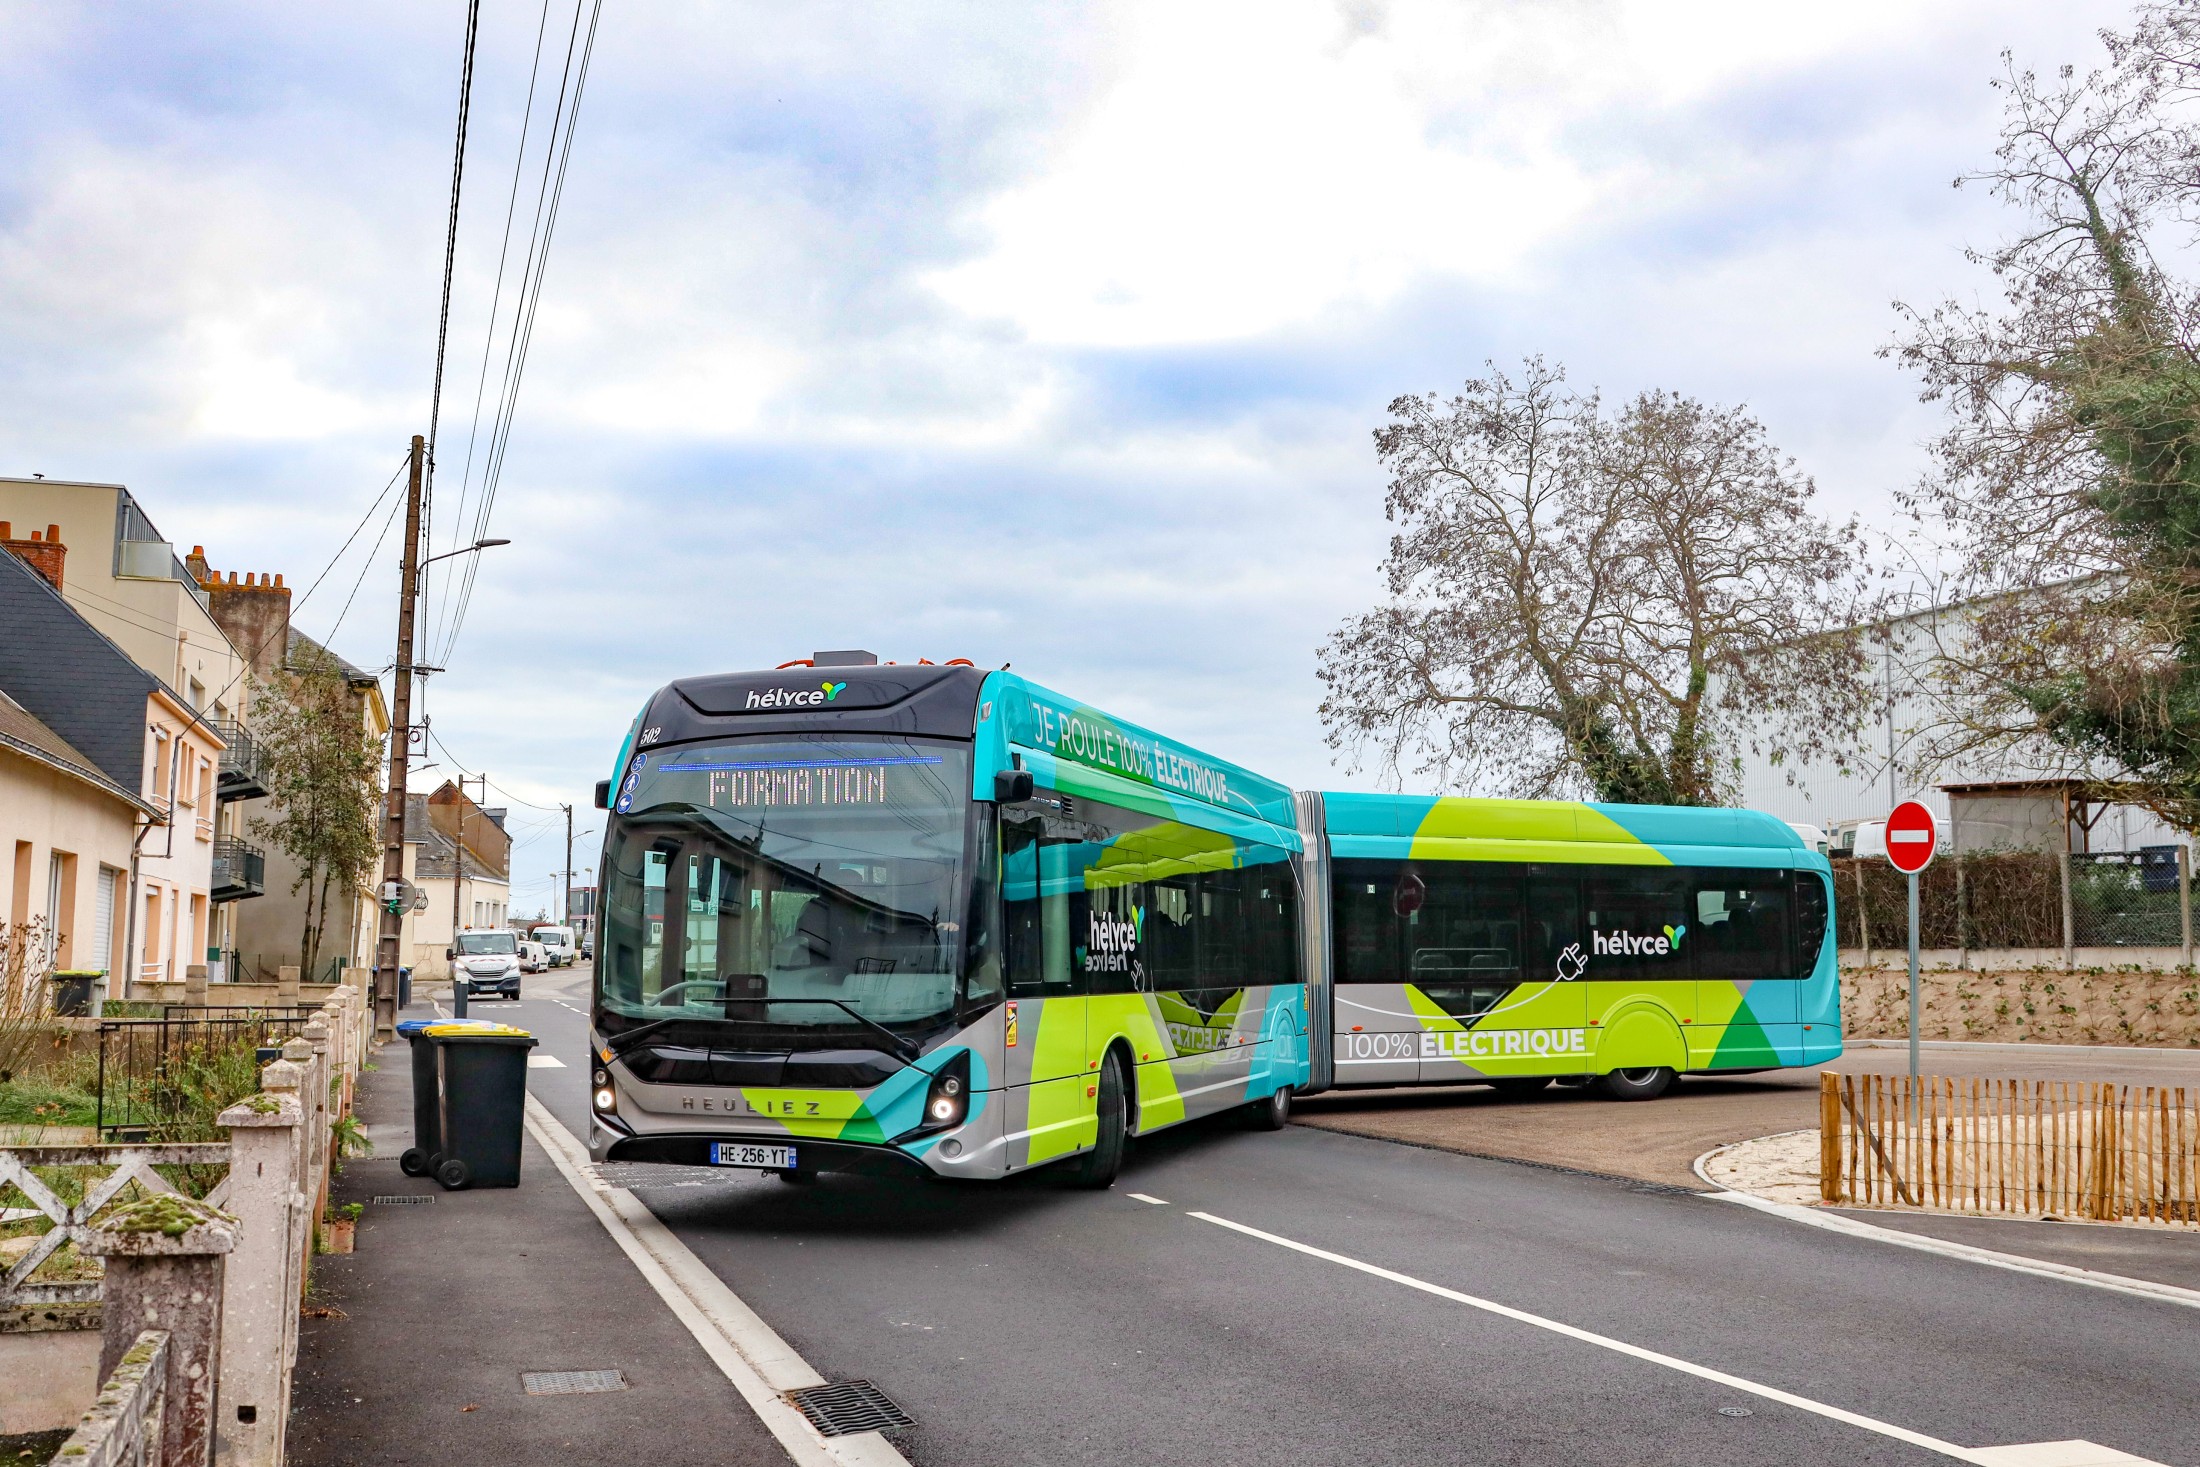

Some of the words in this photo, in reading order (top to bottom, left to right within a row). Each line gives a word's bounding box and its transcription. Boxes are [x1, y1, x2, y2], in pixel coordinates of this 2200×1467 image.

[745, 689, 824, 709] hélyce
[640, 726, 661, 745] 502
[1032, 702, 1056, 748] JE
[1058, 712, 1116, 767] ROULE
[1117, 735, 1153, 779] 100%
[1155, 741, 1229, 804] ÉLECTRIQUE
[708, 766, 885, 806] FORMATION
[1090, 910, 1136, 952] hélyce
[1593, 930, 1669, 956] hélyce
[1344, 1033, 1412, 1058] 100%
[1421, 1027, 1586, 1058] ÉLECTRIQUE
[682, 1096, 819, 1115] HEULIEZ
[720, 1146, 786, 1164] HE-256-YT
